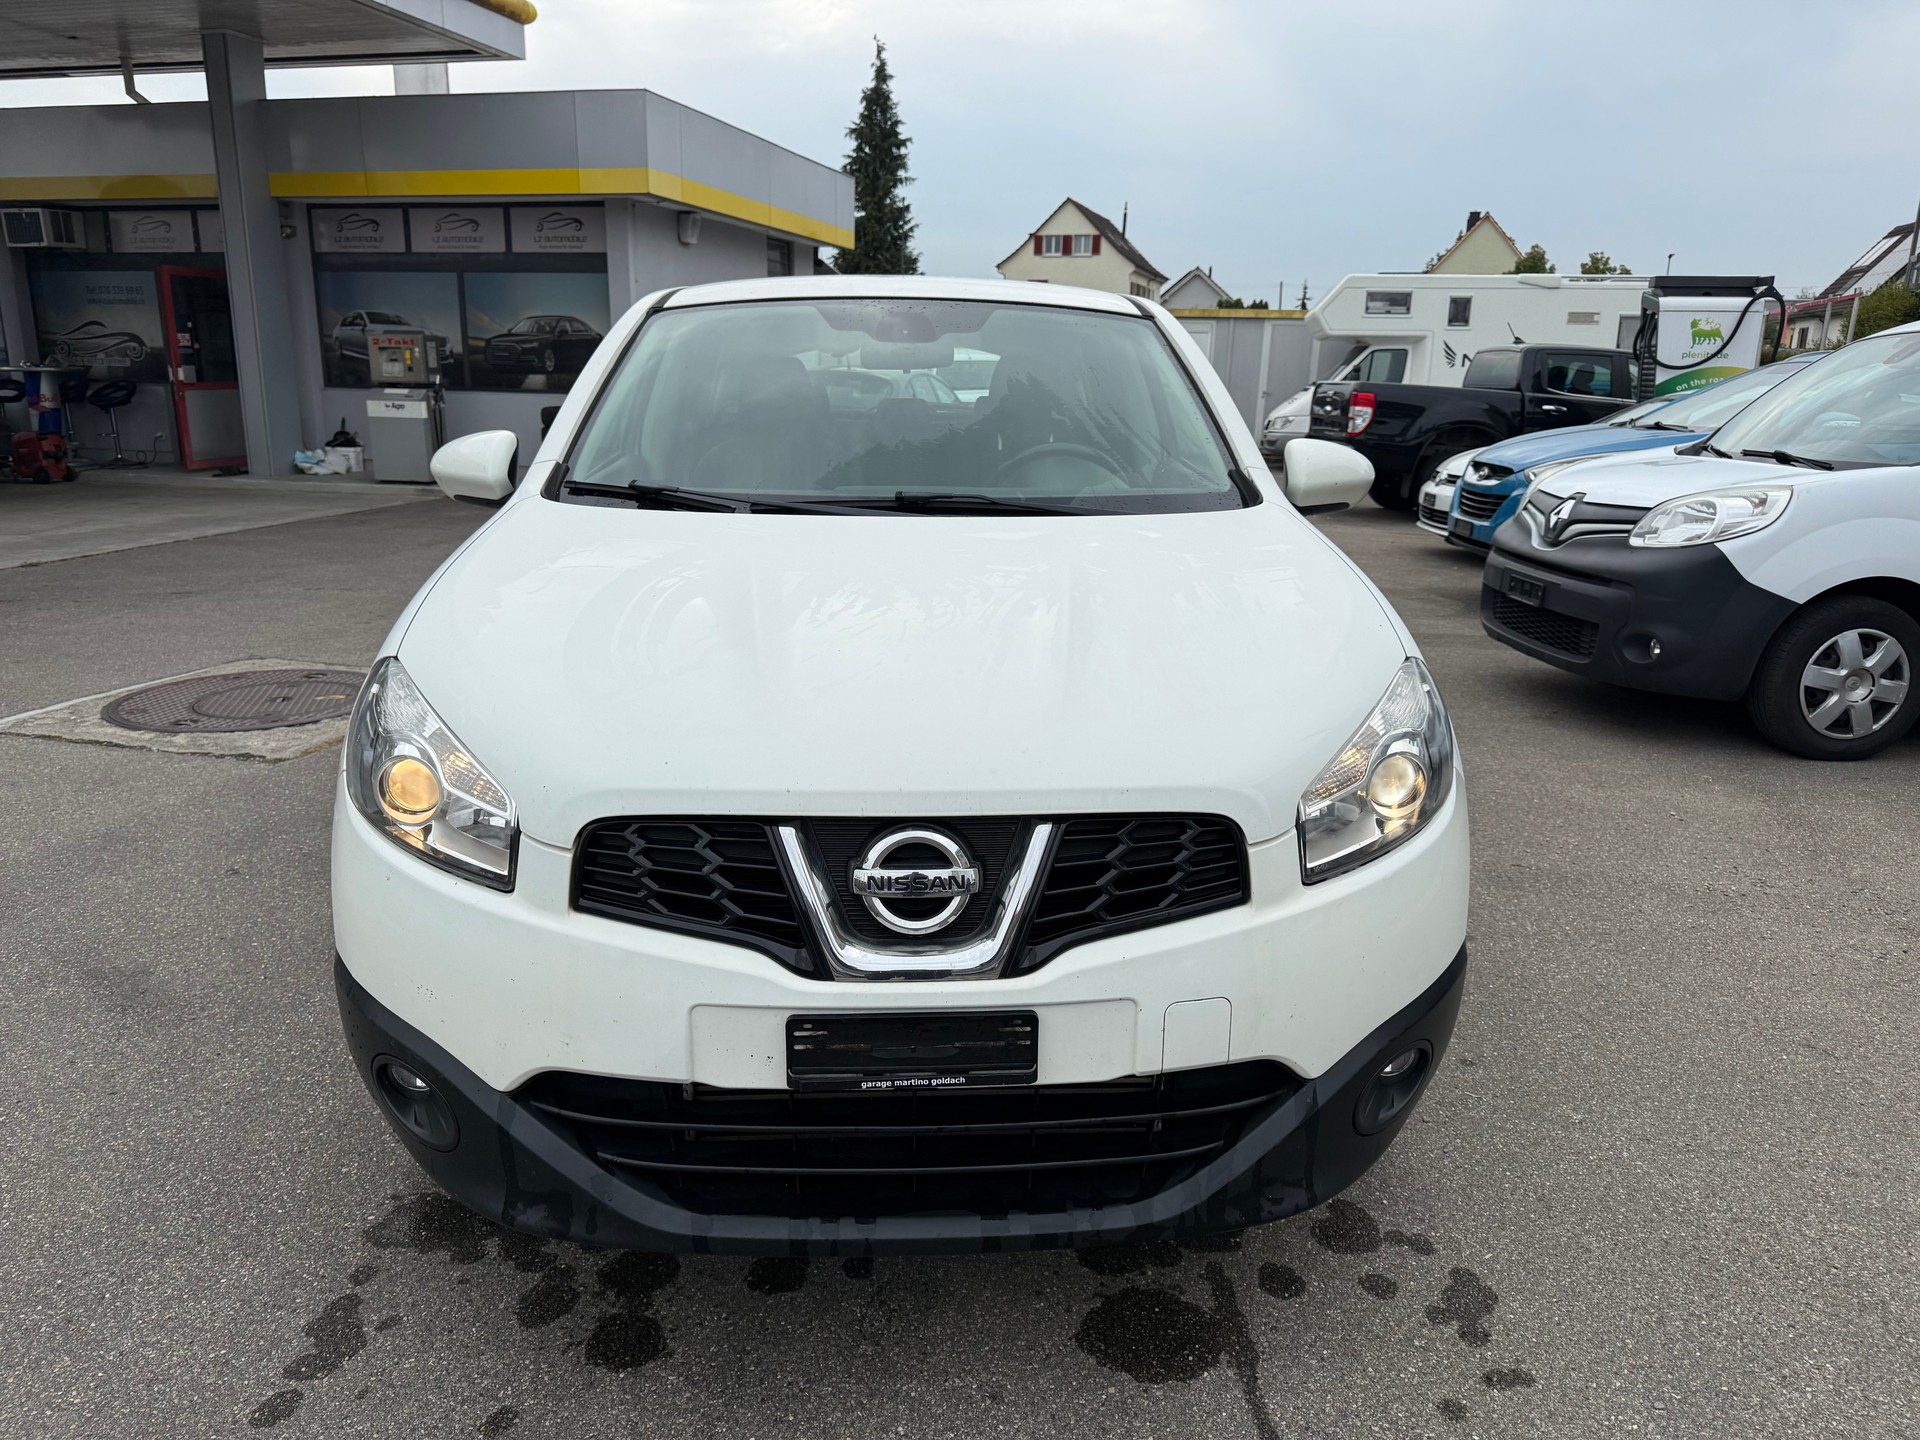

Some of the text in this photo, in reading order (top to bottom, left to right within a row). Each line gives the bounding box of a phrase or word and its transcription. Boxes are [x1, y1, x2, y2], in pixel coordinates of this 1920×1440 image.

[371, 336, 415, 346] 2-Takt
[1681, 351, 1729, 360] plenitde
[1676, 384, 1688, 392] on
[1690, 378, 1706, 387] the
[866, 874, 966, 892] NISSAN
[861, 1076, 966, 1089] garage martino goldach
